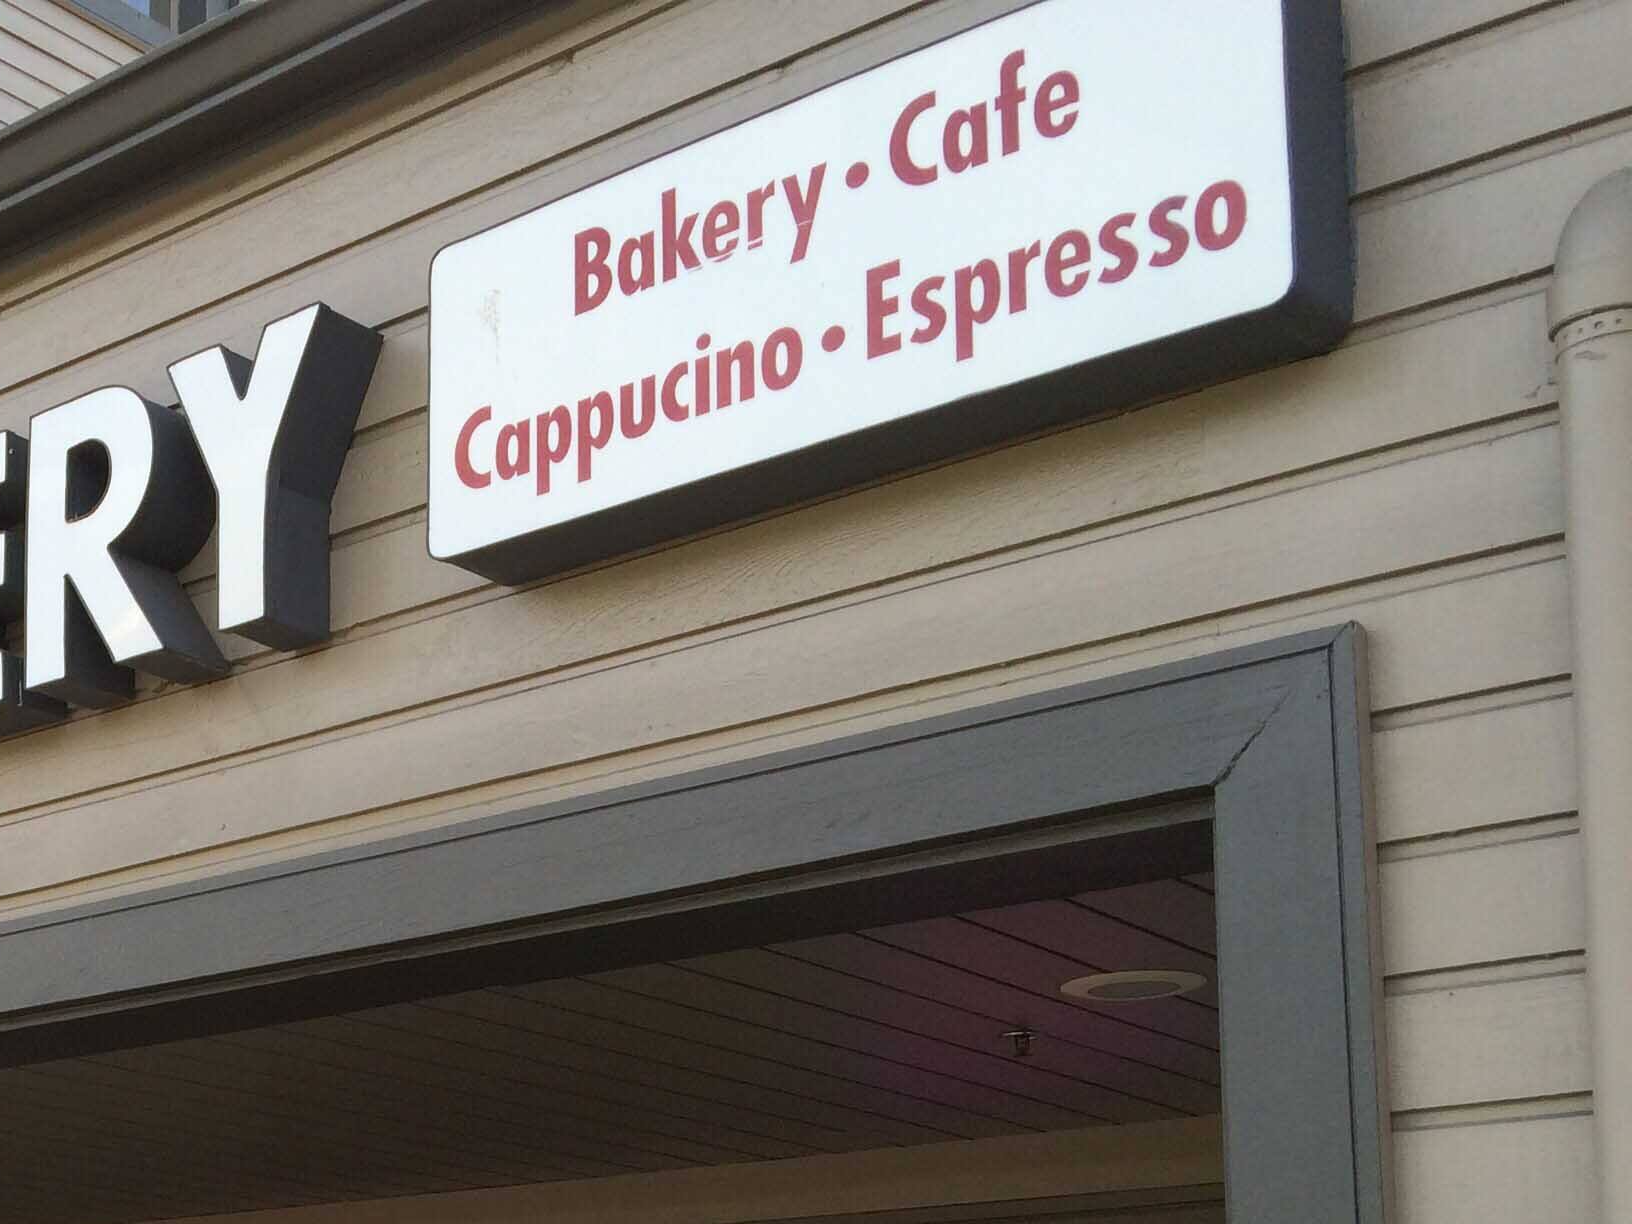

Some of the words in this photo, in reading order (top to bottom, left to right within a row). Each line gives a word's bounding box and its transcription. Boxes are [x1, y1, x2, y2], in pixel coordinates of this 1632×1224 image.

[573, 160, 828, 316] Bakery
[889, 49, 1081, 187] Cafe
[453, 323, 804, 496] Cappucino
[864, 179, 1248, 363] Espresso
